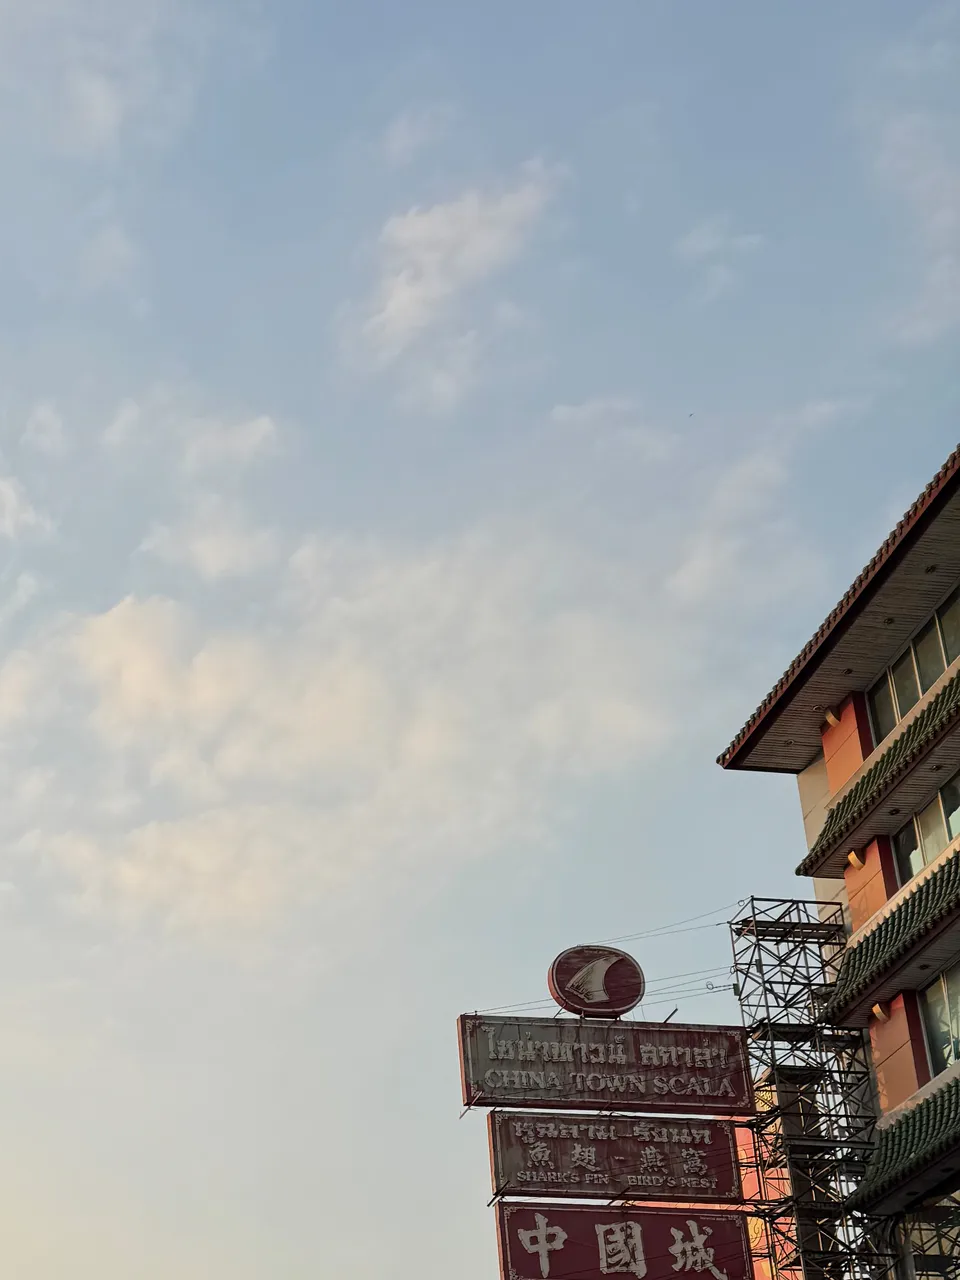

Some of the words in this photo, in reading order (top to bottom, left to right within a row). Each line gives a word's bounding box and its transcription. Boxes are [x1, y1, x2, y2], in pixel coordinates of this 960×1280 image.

[484, 1069, 563, 1090] CHINA
[570, 1072, 645, 1094] TOWN
[653, 1075, 736, 1098] SCALA
[516, 1170, 579, 1184] SHARK'S
[585, 1173, 609, 1185] FIN
[628, 1174, 676, 1188] BIRD'S
[681, 1176, 717, 1190] NEST
